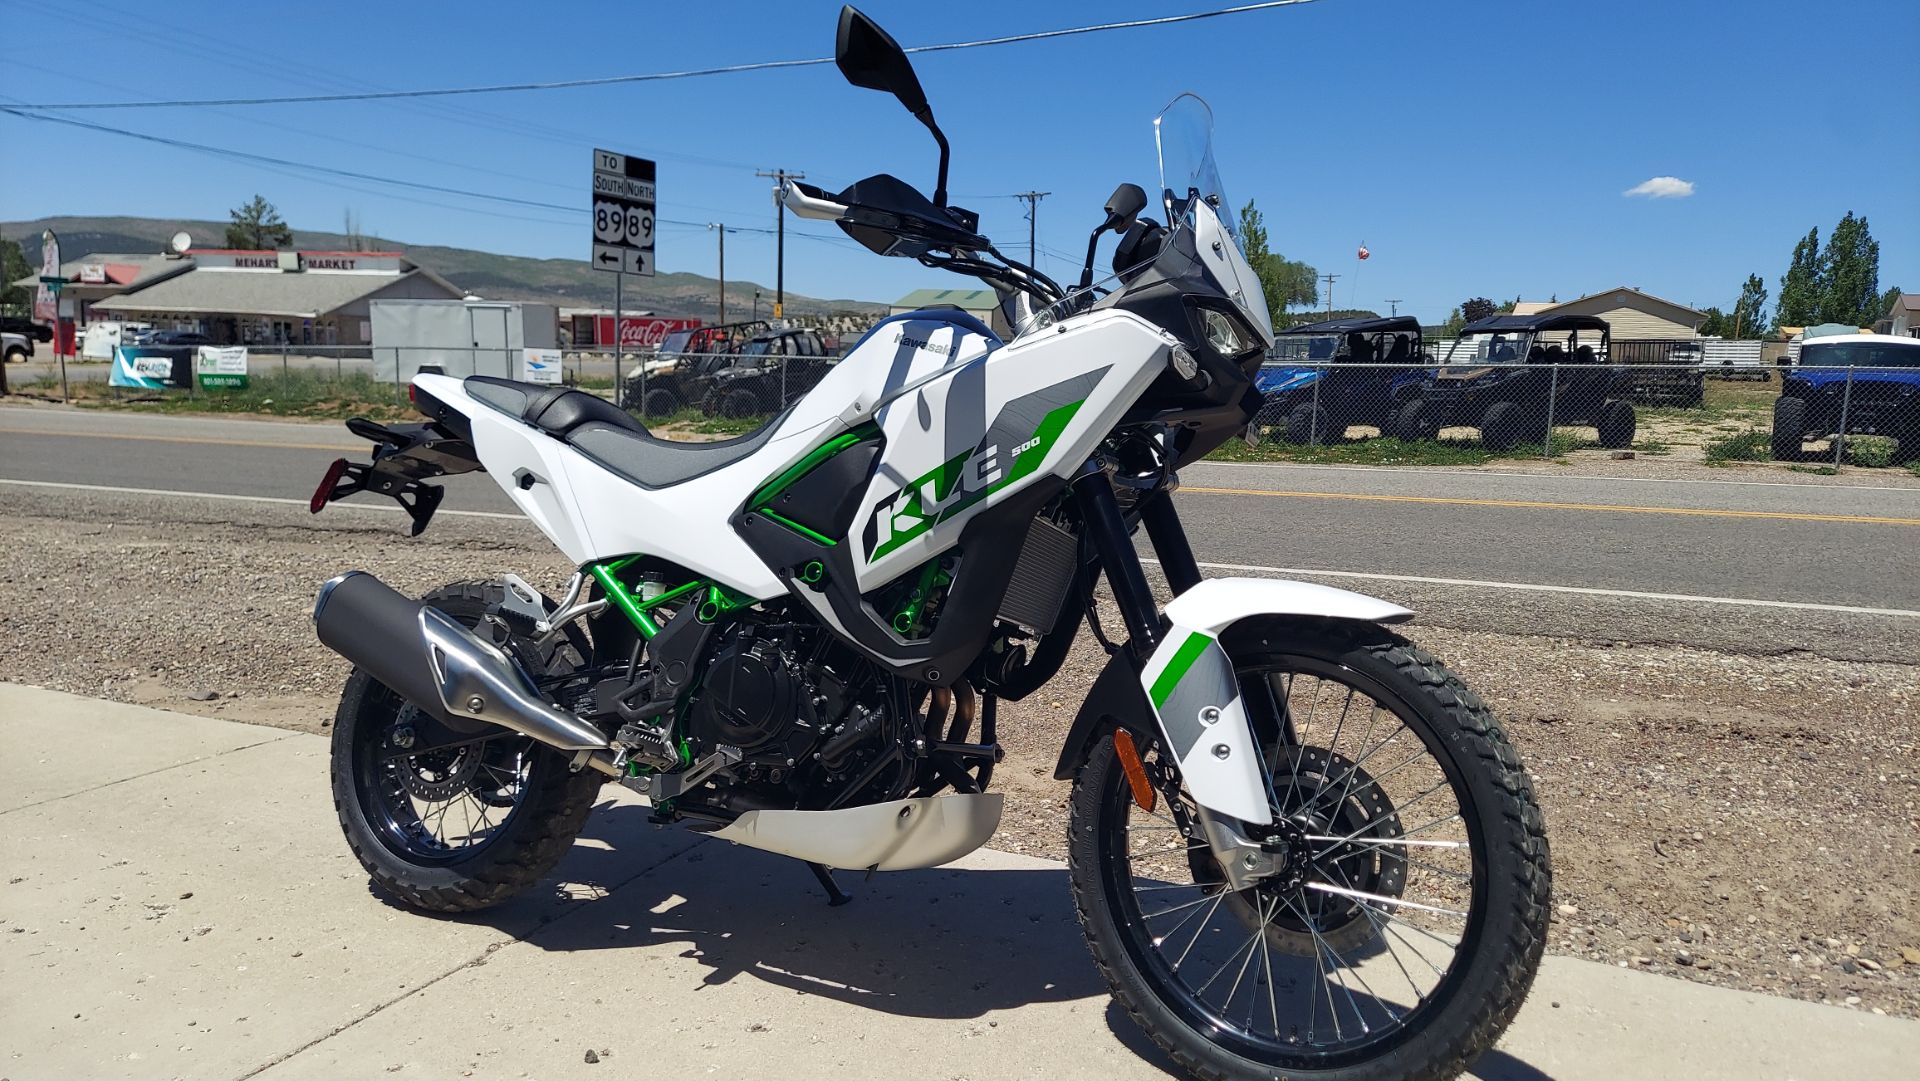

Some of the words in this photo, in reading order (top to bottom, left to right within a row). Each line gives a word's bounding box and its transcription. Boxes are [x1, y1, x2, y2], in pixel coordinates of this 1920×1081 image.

[602, 155, 618, 169] TO
[595, 175, 624, 193] SOUTH
[627, 181, 655, 199] NORTH
[597, 208, 622, 233] 89
[628, 215, 652, 238] 89
[308, 259, 356, 270] MARKET
[620, 319, 675, 346] Coca-Col
[893, 332, 957, 357] Kawasaki
[875, 444, 1003, 548] KLE
[1011, 436, 1041, 458] 500
